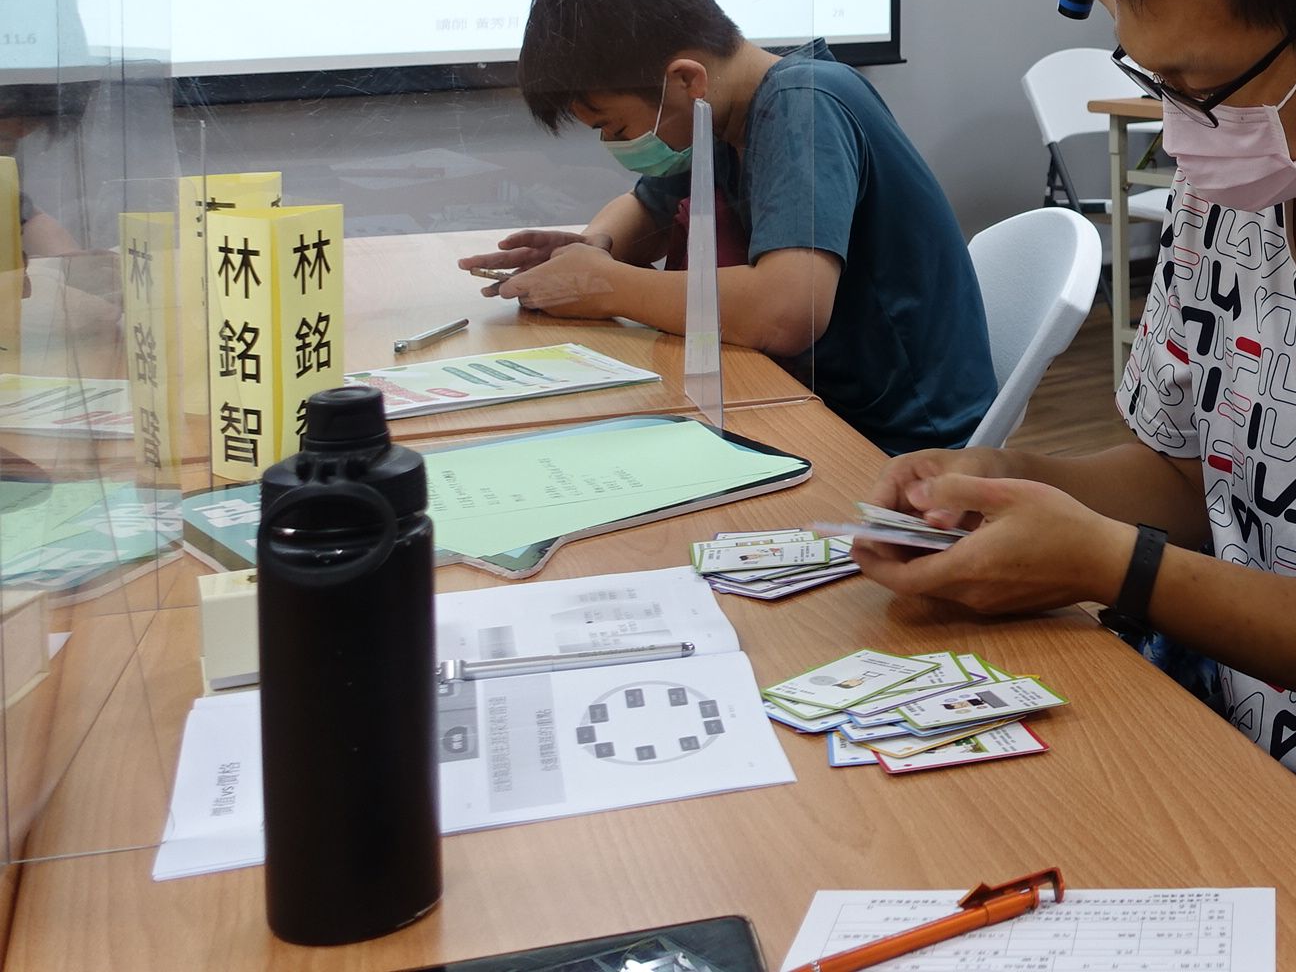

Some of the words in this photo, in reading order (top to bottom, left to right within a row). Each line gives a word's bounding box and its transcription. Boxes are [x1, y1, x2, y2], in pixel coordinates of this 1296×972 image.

[217, 235, 262, 467] 林銘智
[292, 229, 331, 452] 林銘
